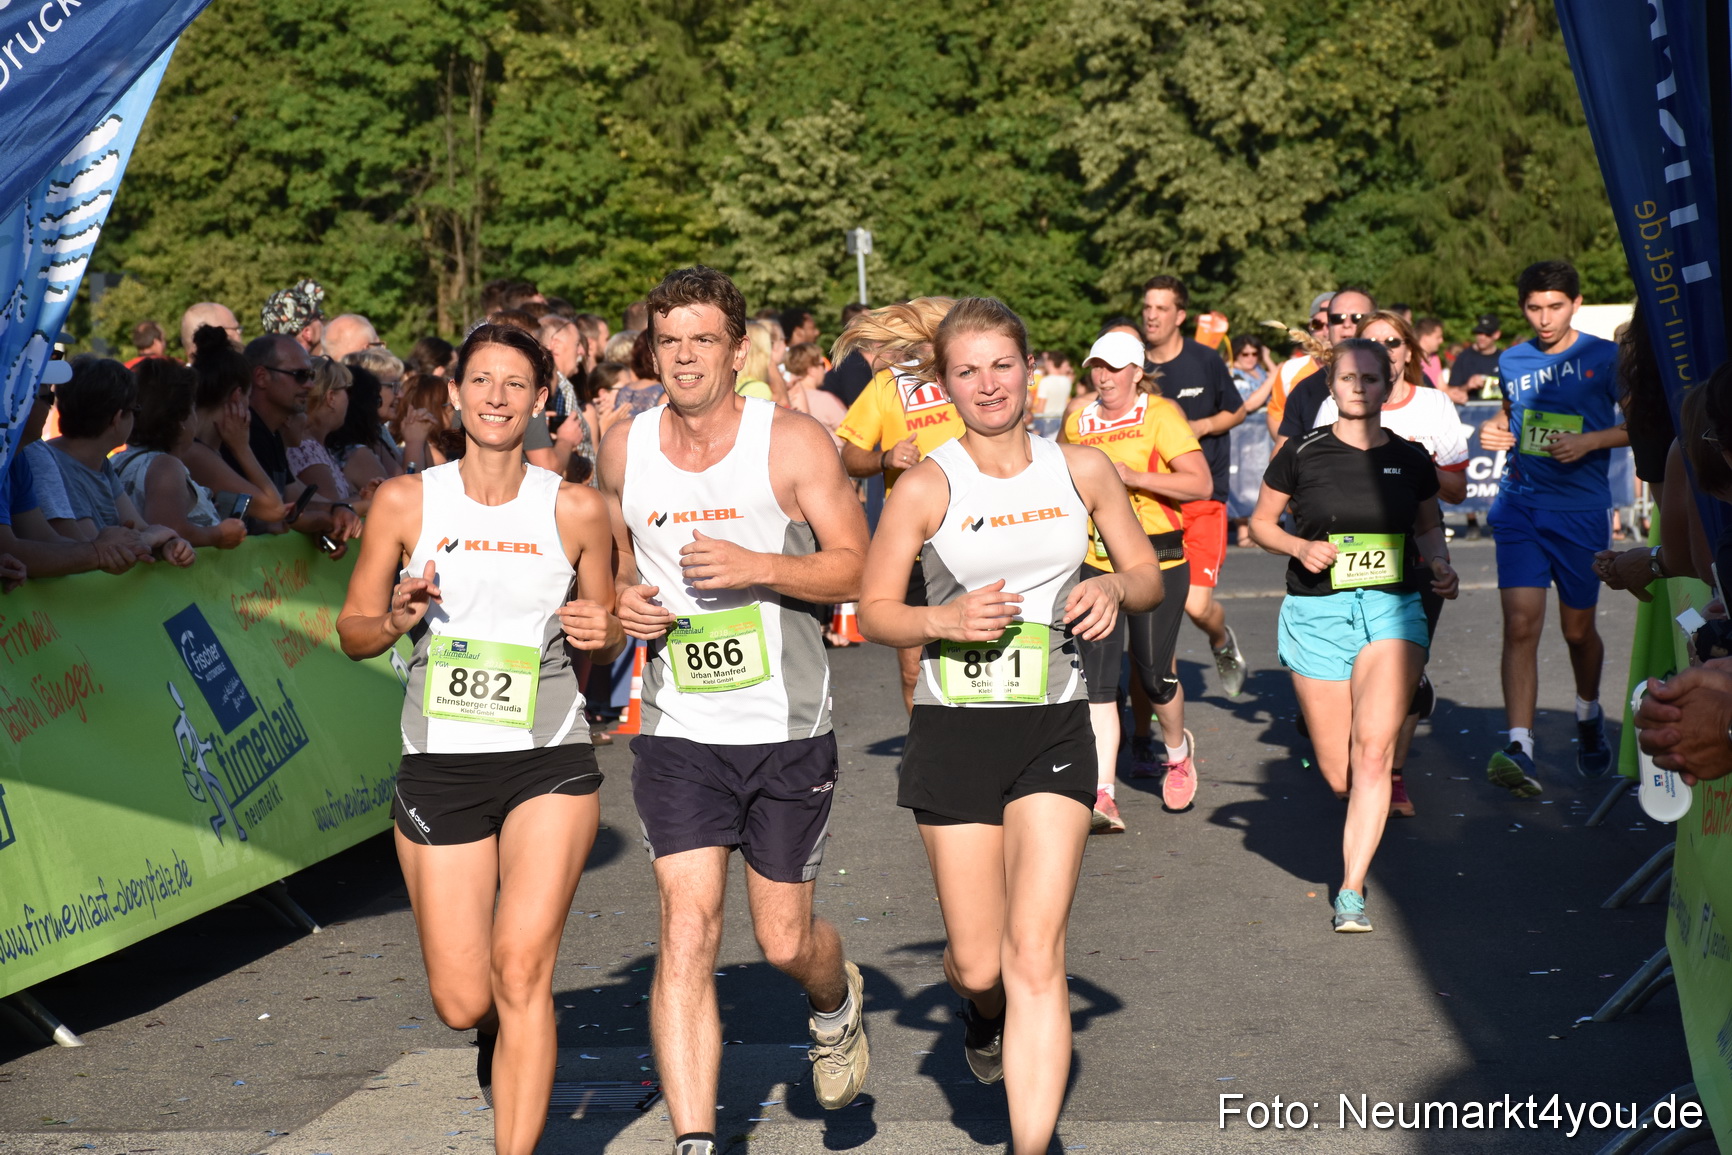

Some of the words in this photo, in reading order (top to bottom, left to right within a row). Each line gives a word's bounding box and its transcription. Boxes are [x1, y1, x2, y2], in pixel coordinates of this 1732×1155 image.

[906, 411, 951, 432] MAX
[1108, 429, 1145, 443] BÖGL
[1383, 467, 1402, 475] NICOLE
[673, 508, 745, 524] KLEBL
[990, 506, 1070, 528] KLEBL
[464, 539, 544, 556] KLEBL
[1345, 550, 1386, 571] 742
[190, 643, 222, 673] Fischer
[444, 648, 481, 660] firmenlauf
[685, 638, 744, 671] 866
[964, 649, 1021, 679] 881
[691, 670, 712, 679] Urban
[713, 666, 747, 678] Manfred
[449, 667, 512, 703] 882
[436, 696, 488, 710] Ehrnsberger
[490, 702, 522, 713] Claudia
[476, 709, 495, 717] GmbH
[209, 678, 310, 801] firmenlauf
[244, 779, 284, 830] neumarkt
